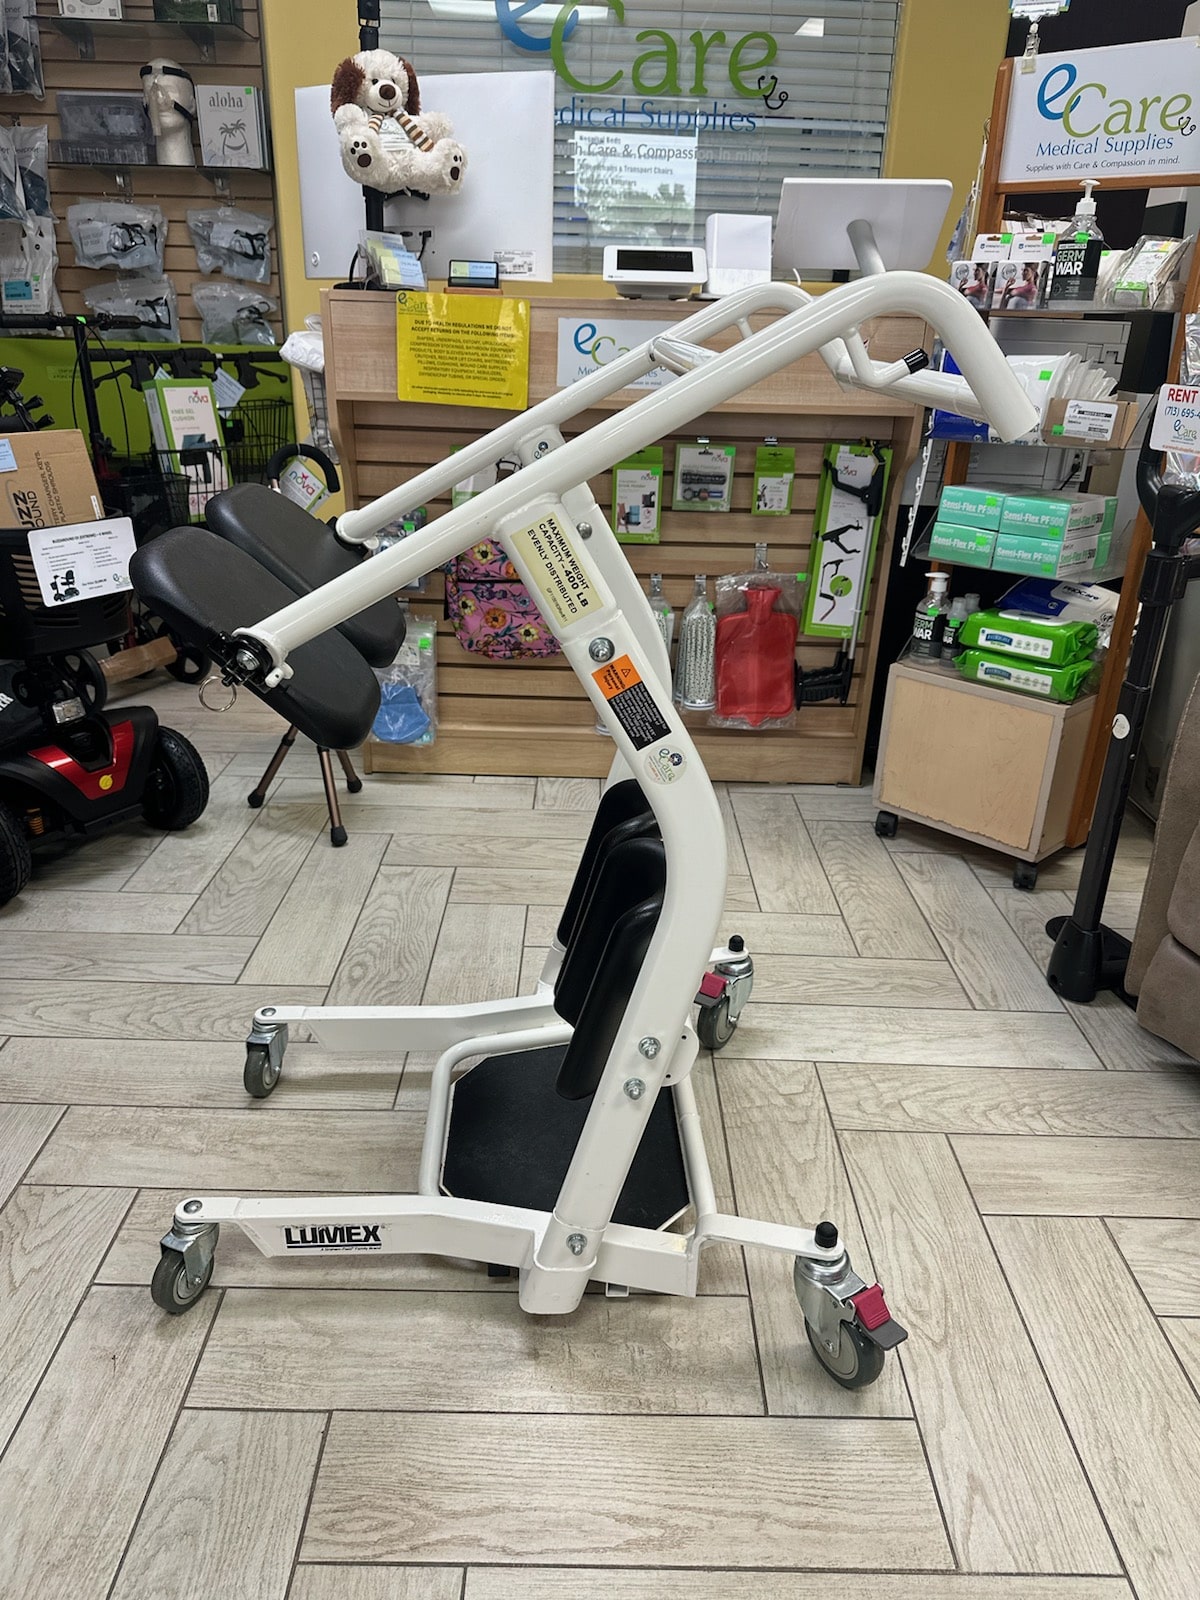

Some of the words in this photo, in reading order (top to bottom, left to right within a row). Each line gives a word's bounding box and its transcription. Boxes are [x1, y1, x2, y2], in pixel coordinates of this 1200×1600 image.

[209, 92, 243, 108] aloha
[1037, 63, 1192, 138] eCare
[555, 97, 626, 127] dical
[640, 101, 757, 136] Supplies
[588, 143, 617, 156] Care
[638, 144, 715, 162] Compassion
[1036, 137, 1098, 157] Medical
[1104, 134, 1174, 156] Supplies
[1026, 164, 1054, 172] Supplies
[1074, 160, 1090, 170] Care
[1092, 160, 1098, 168] &
[1101, 158, 1146, 170] Compassion
[1148, 158, 1156, 166] in
[1158, 156, 1180, 164] mind.
[1057, 250, 1085, 262] GERM
[1056, 262, 1082, 276] WAR
[188, 395, 208, 404] nova
[1168, 388, 1199, 404] RENT
[1165, 406, 1179, 417] (713)
[289, 470, 315, 496] nova
[27, 490, 45, 527] OUND
[942, 499, 976, 512] Sensi-Flex
[1003, 511, 1039, 523] Sensi-Flex
[546, 518, 572, 558] MAXIMUM
[568, 558, 590, 590] WEIGHT
[997, 548, 1032, 560] Sensi-Flex
[528, 529, 549, 560] EVENLY
[545, 562, 577, 613] DISTRIBUTED
[565, 570, 579, 590] 400
[577, 592, 589, 607] LB
[606, 670, 621, 690] Personal
[284, 1225, 382, 1244] LUMEX
